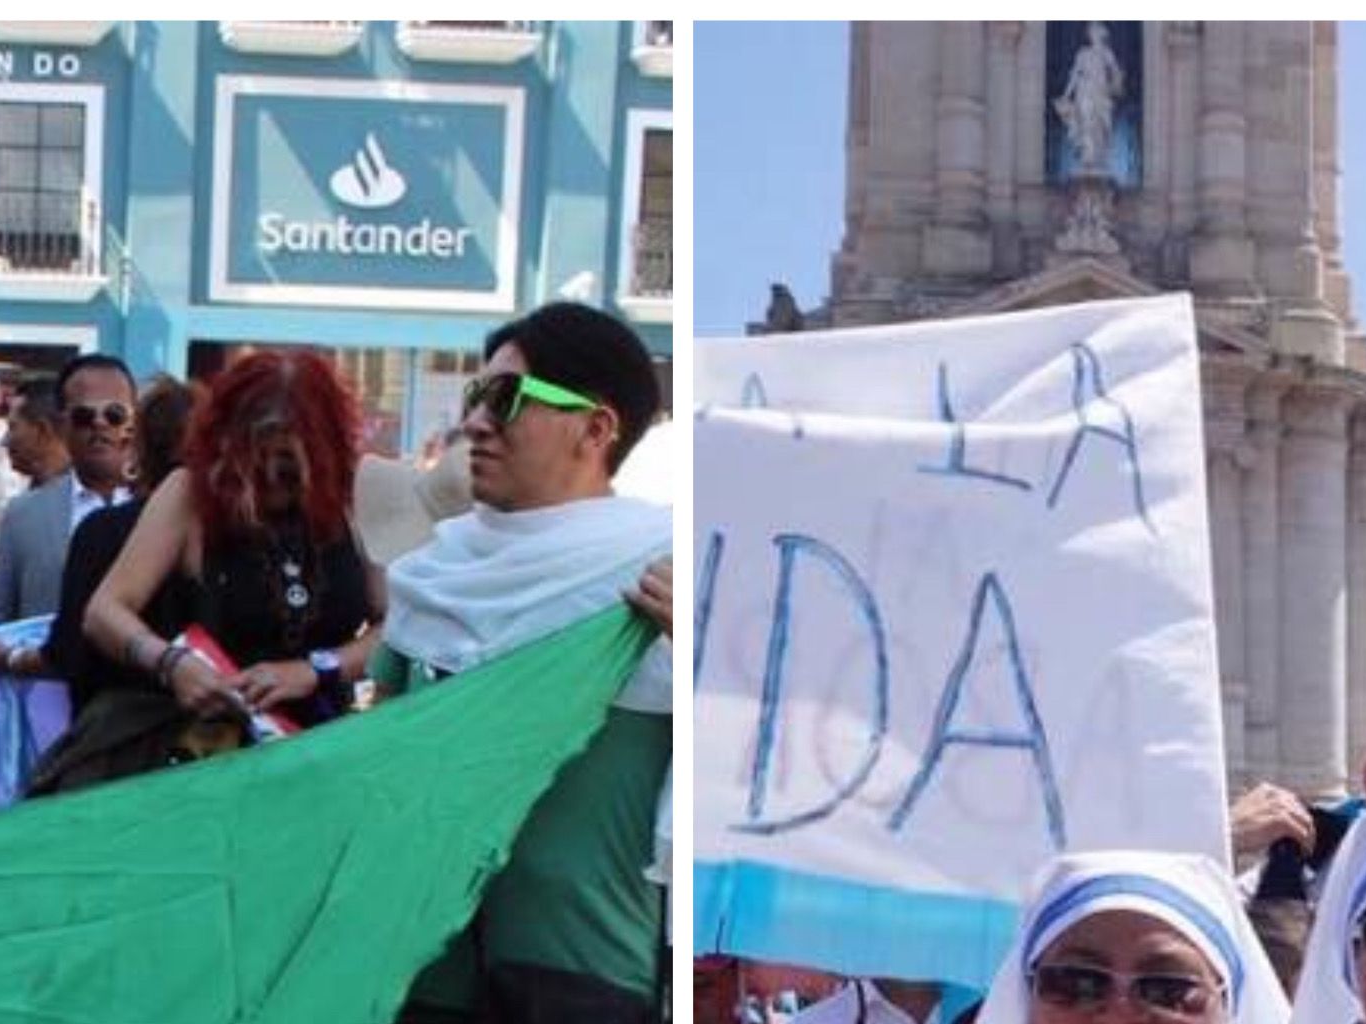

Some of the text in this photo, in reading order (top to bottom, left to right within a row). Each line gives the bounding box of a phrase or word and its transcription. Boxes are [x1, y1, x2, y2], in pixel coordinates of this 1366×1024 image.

[35, 53, 82, 78] DO
[257, 211, 472, 260] Santander
[916, 341, 1159, 538] LA
[693, 531, 1066, 850] IDA
